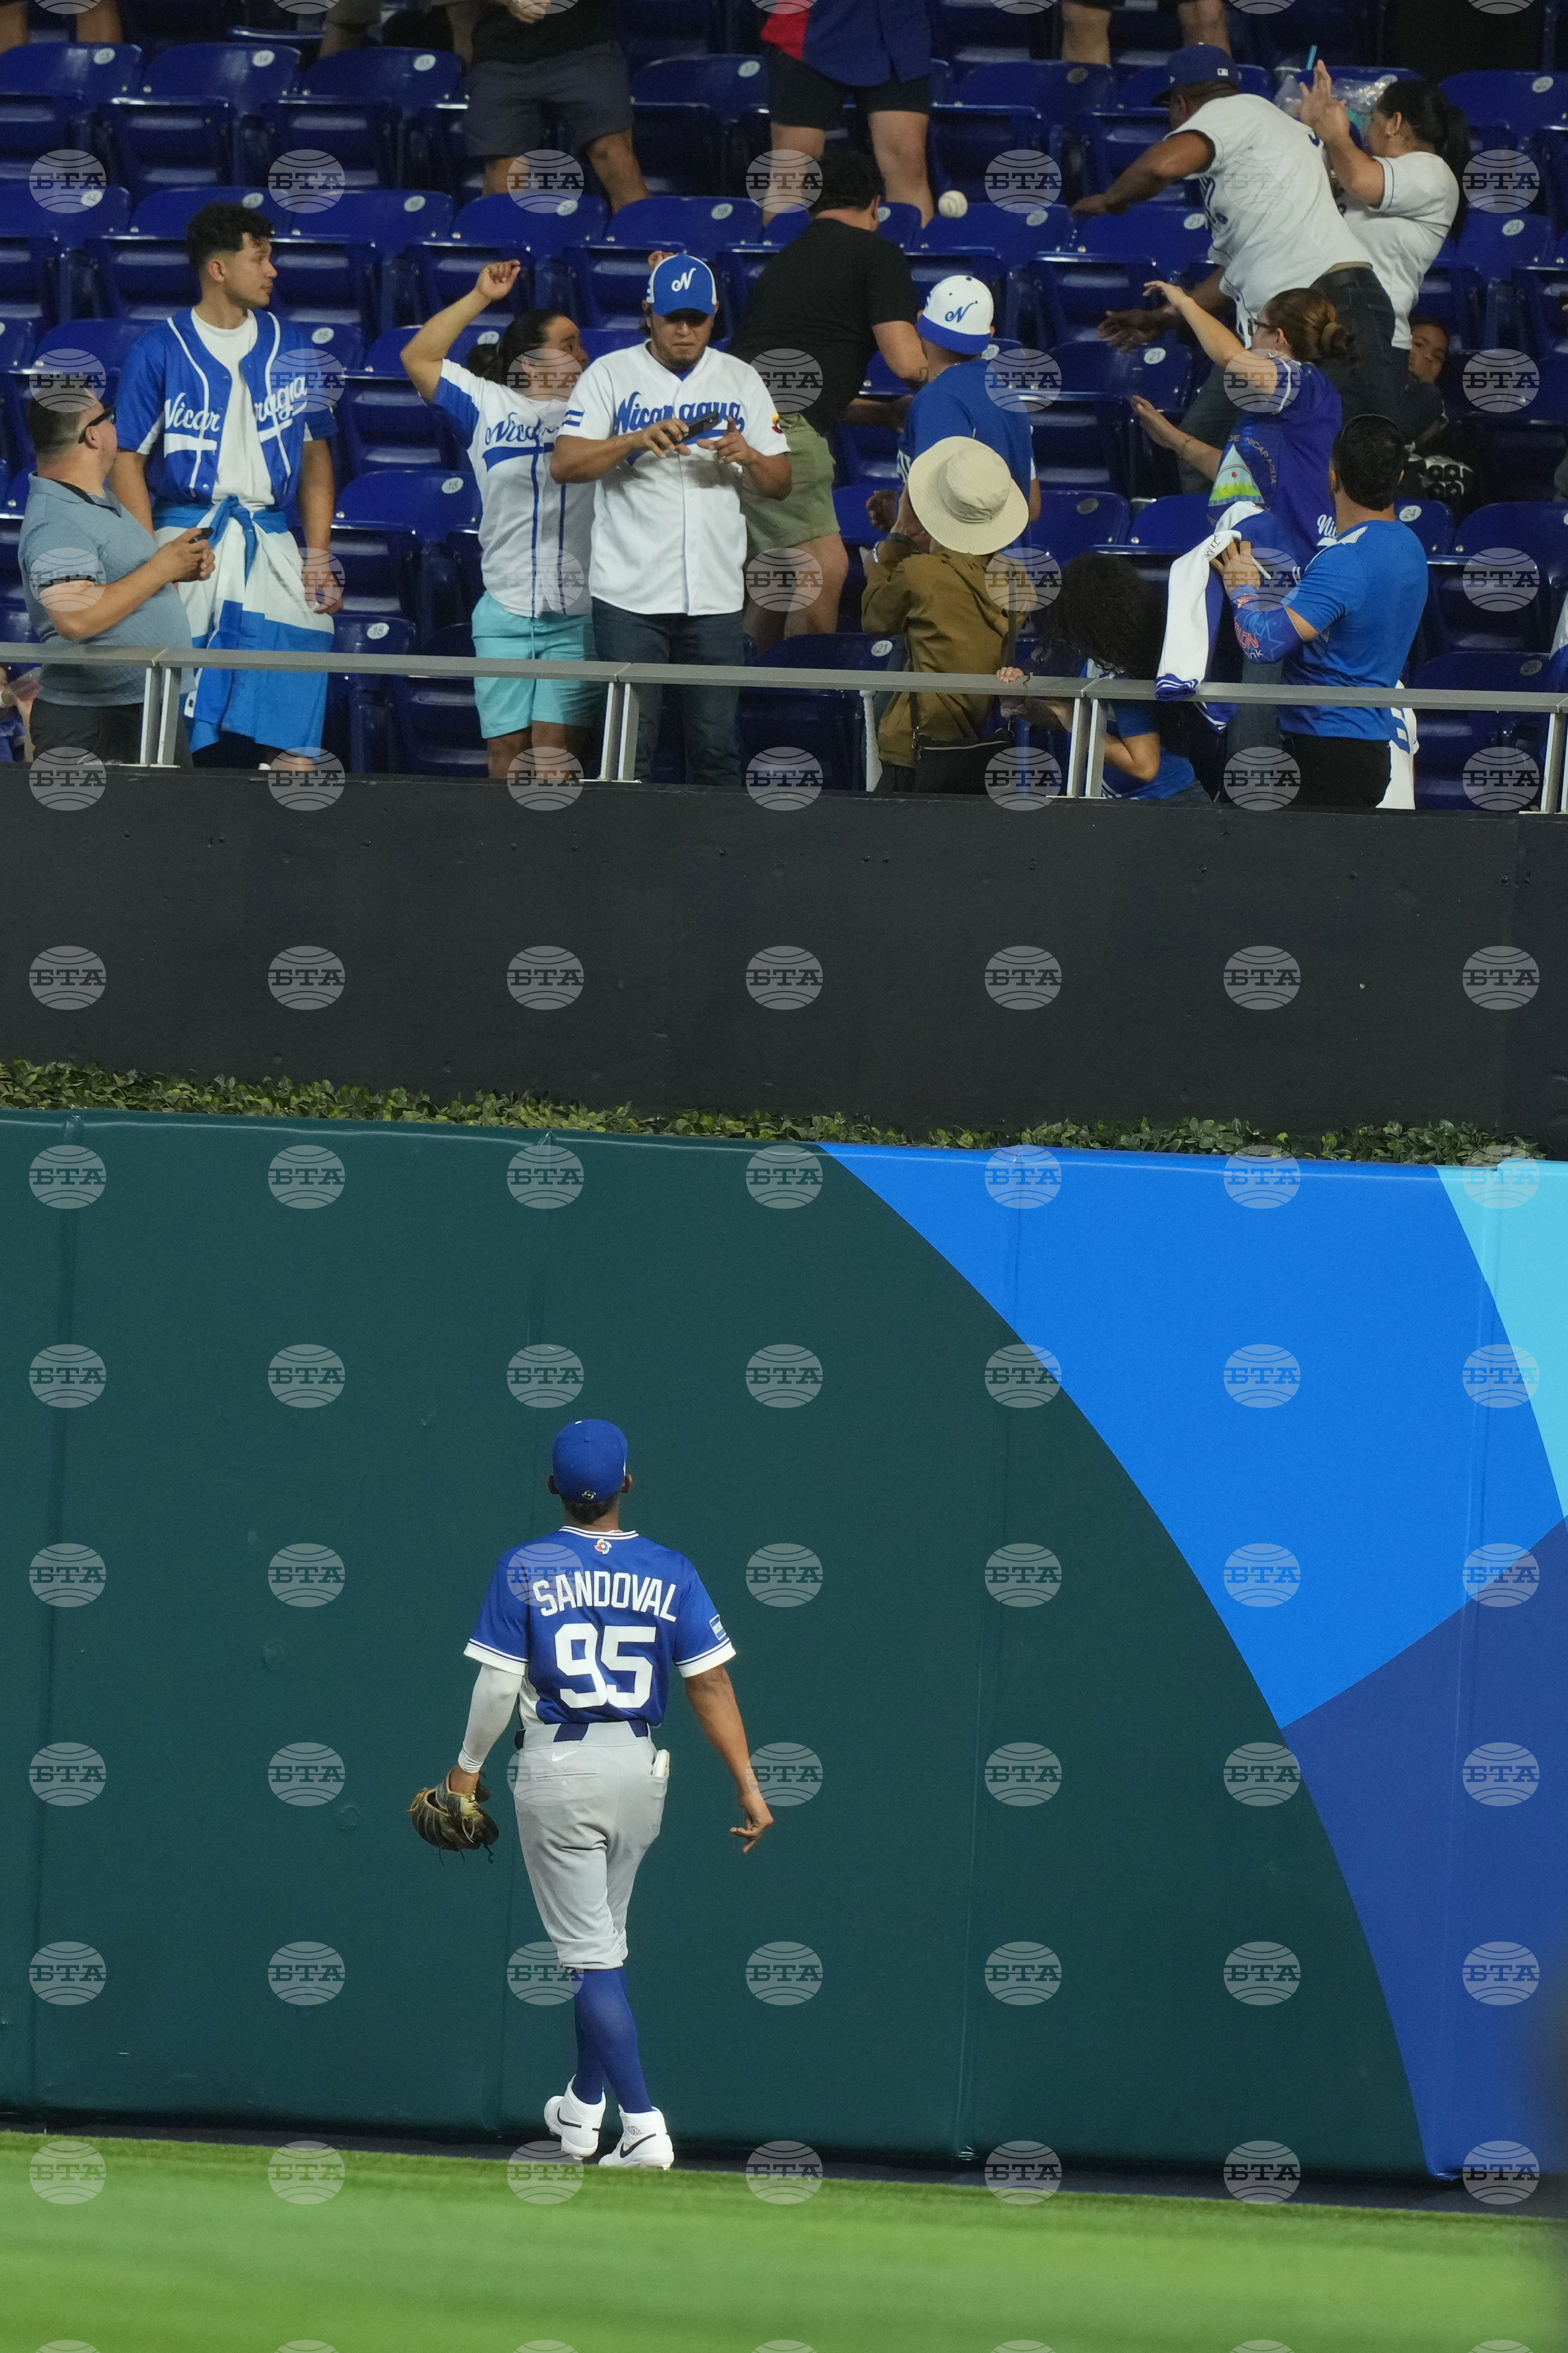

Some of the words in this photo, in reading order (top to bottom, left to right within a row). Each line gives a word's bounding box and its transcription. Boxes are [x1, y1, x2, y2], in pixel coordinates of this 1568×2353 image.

[1403, 508, 1417, 518] 24
[875, 643, 889, 654] 21
[533, 1571, 676, 1622] SANDOVAL
[555, 1623, 656, 1708] 95
